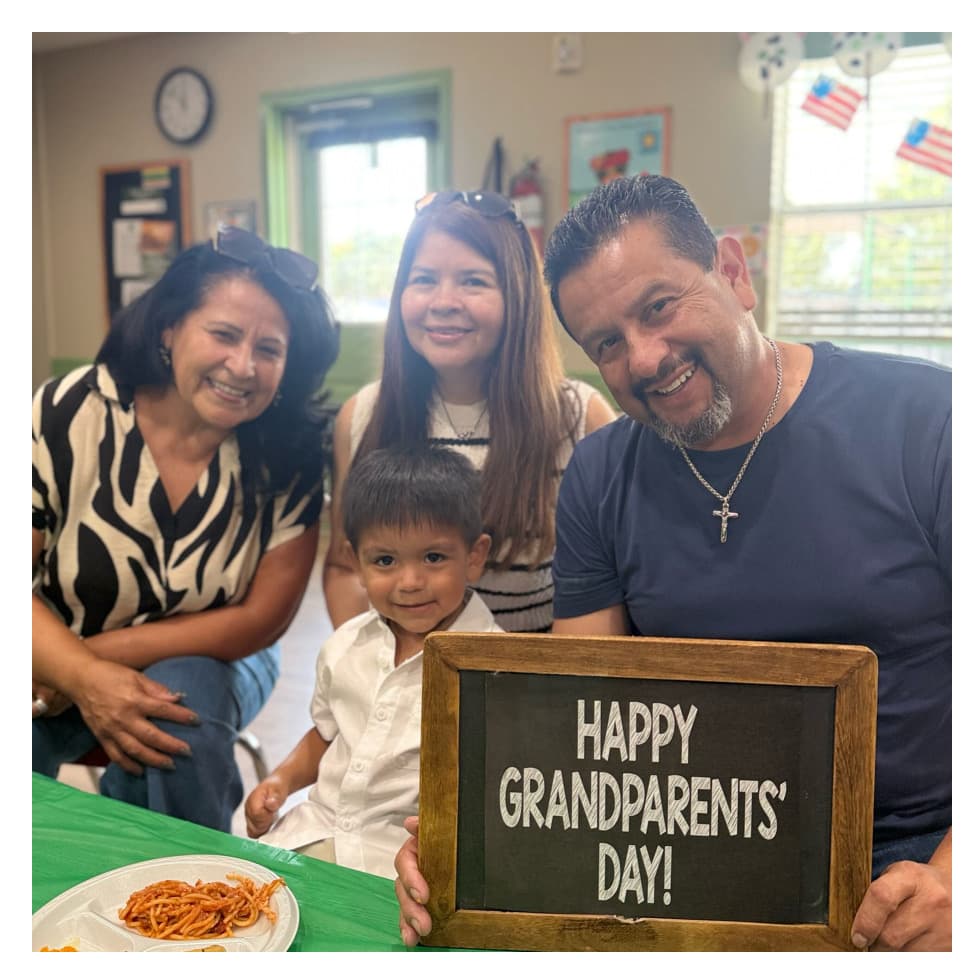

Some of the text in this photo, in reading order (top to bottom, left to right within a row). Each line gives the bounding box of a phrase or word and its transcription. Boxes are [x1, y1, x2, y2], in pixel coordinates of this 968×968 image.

[577, 699, 698, 764] HAPPY
[499, 766, 787, 840] GRANDPARENTS'
[598, 842, 673, 906] DAY!
